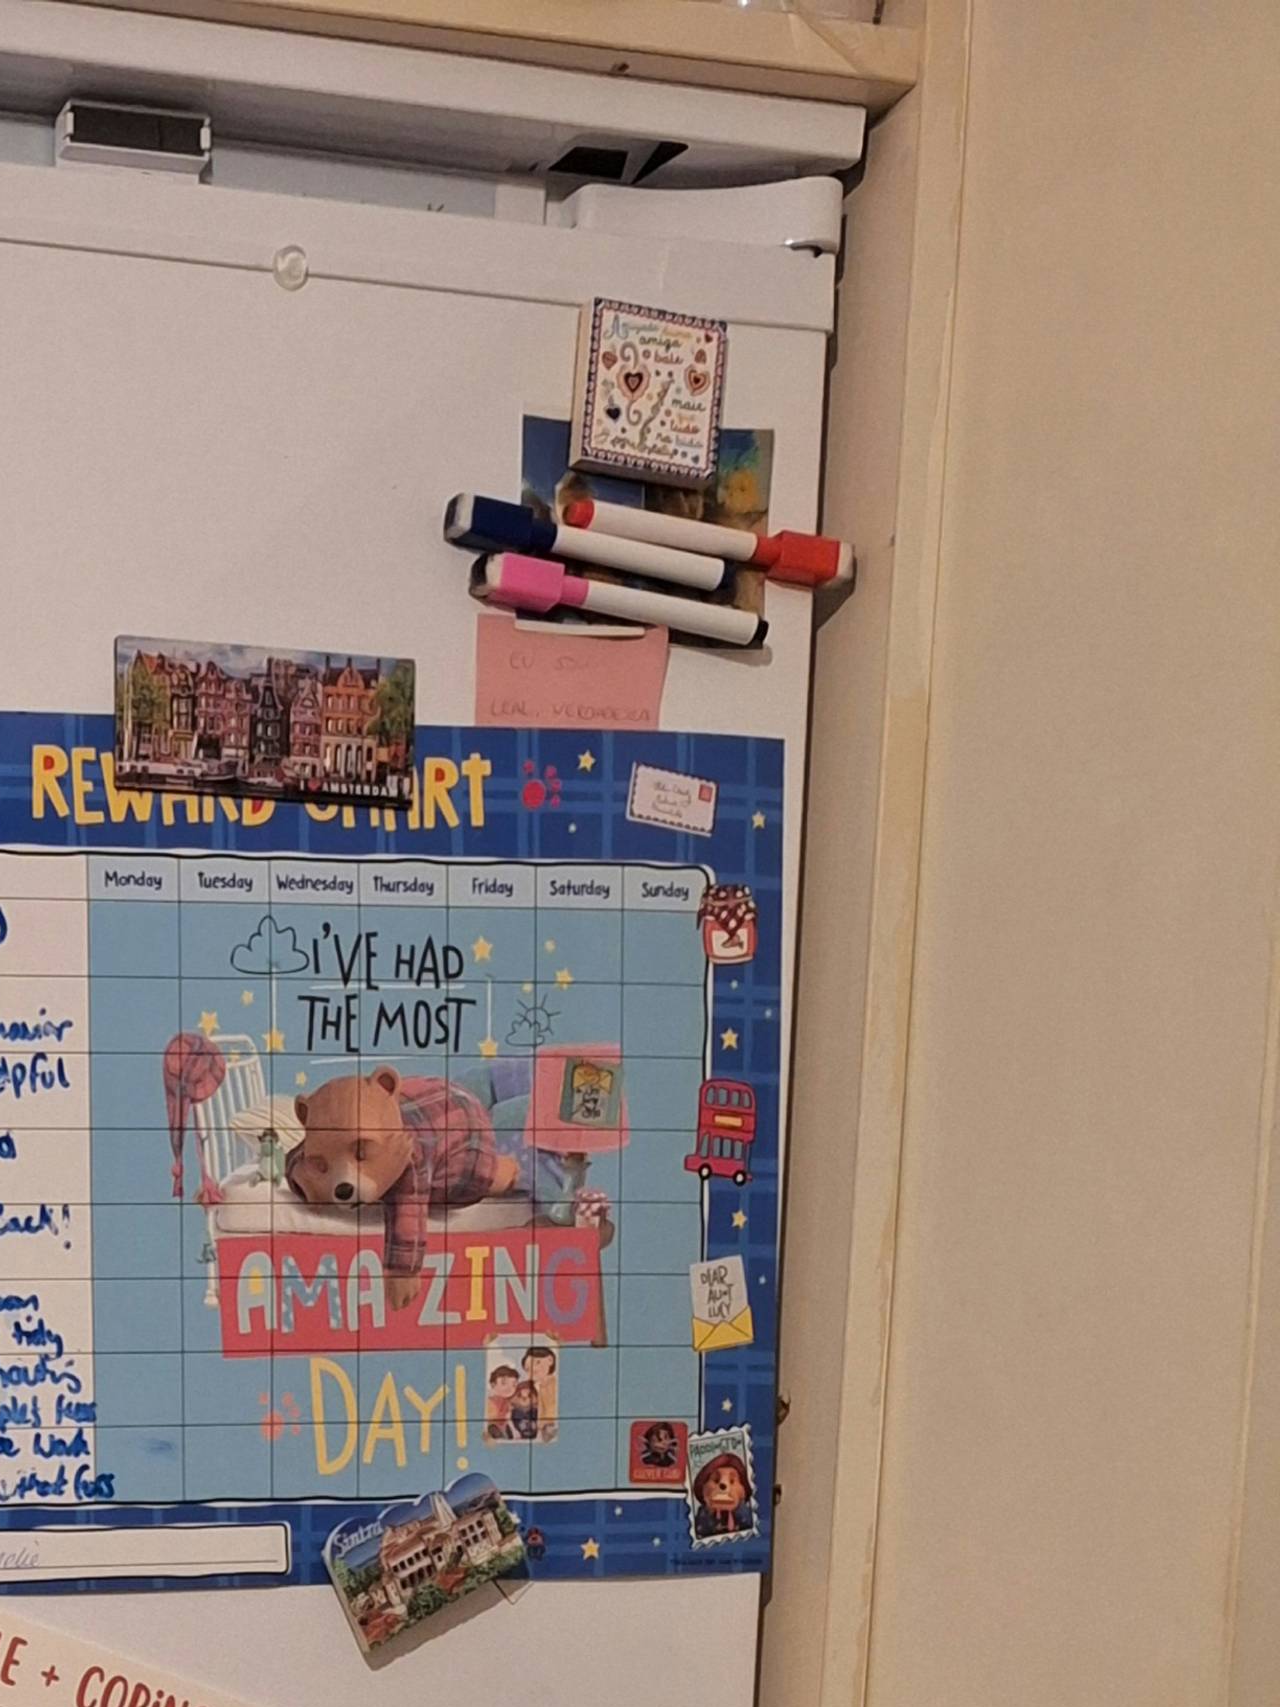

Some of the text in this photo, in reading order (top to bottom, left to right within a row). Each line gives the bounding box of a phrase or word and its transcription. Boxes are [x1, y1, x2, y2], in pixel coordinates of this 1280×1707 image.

[321, 781, 399, 798] AMSTERDAM
[104, 870, 163, 891] Monday
[197, 871, 254, 892] Tuesday
[276, 874, 354, 894] Wednesday
[373, 876, 435, 897] Thursday
[471, 877, 514, 897] Friday
[549, 880, 610, 899] Saturday
[642, 882, 690, 901] Sunday
[312, 922, 464, 989] I'VE HAD
[298, 993, 477, 1053] THE MOST
[708, 1302, 731, 1319] LUCY
[309, 1355, 470, 1476] DAY!
[332, 1520, 384, 1555] Sintra
